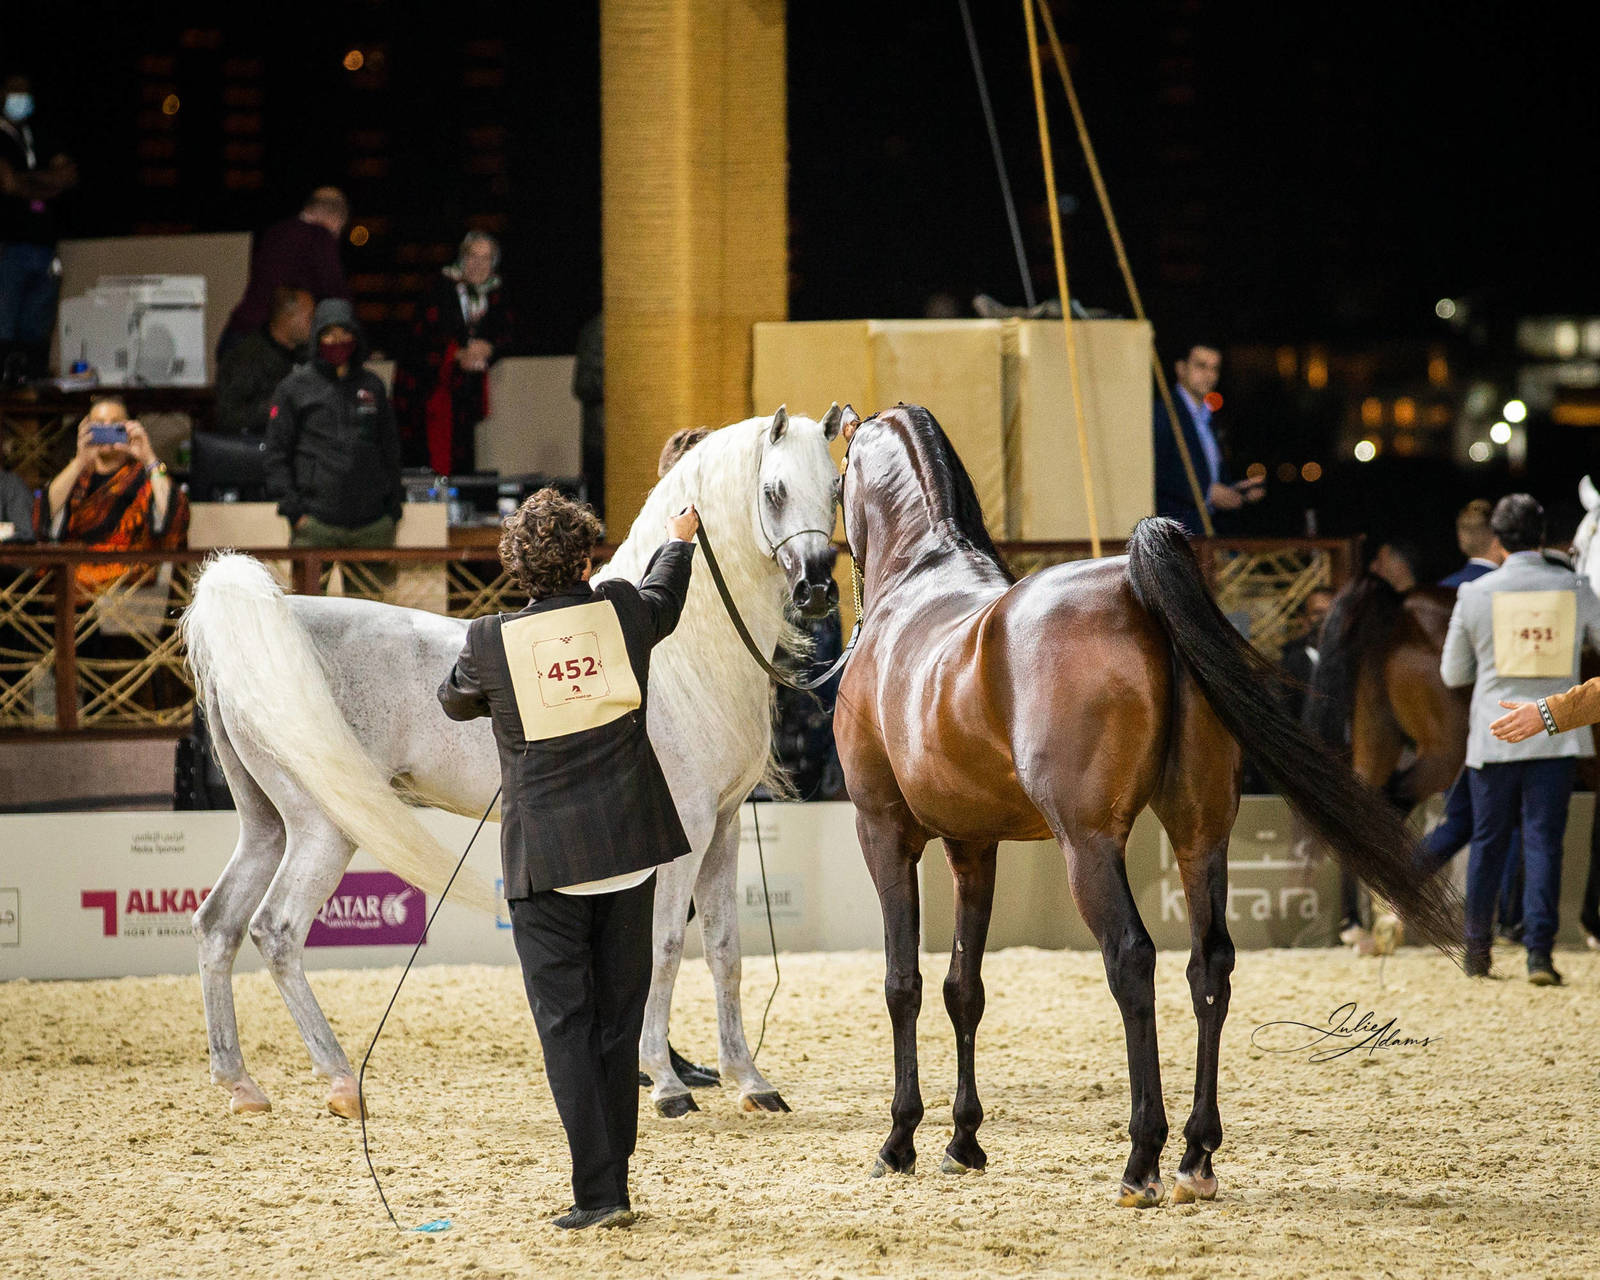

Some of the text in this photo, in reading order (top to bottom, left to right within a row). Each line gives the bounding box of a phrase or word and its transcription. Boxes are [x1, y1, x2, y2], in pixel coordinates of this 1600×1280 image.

[1520, 627, 1552, 641] 451
[547, 656, 598, 682] 452
[1160, 878, 1319, 922] ktara
